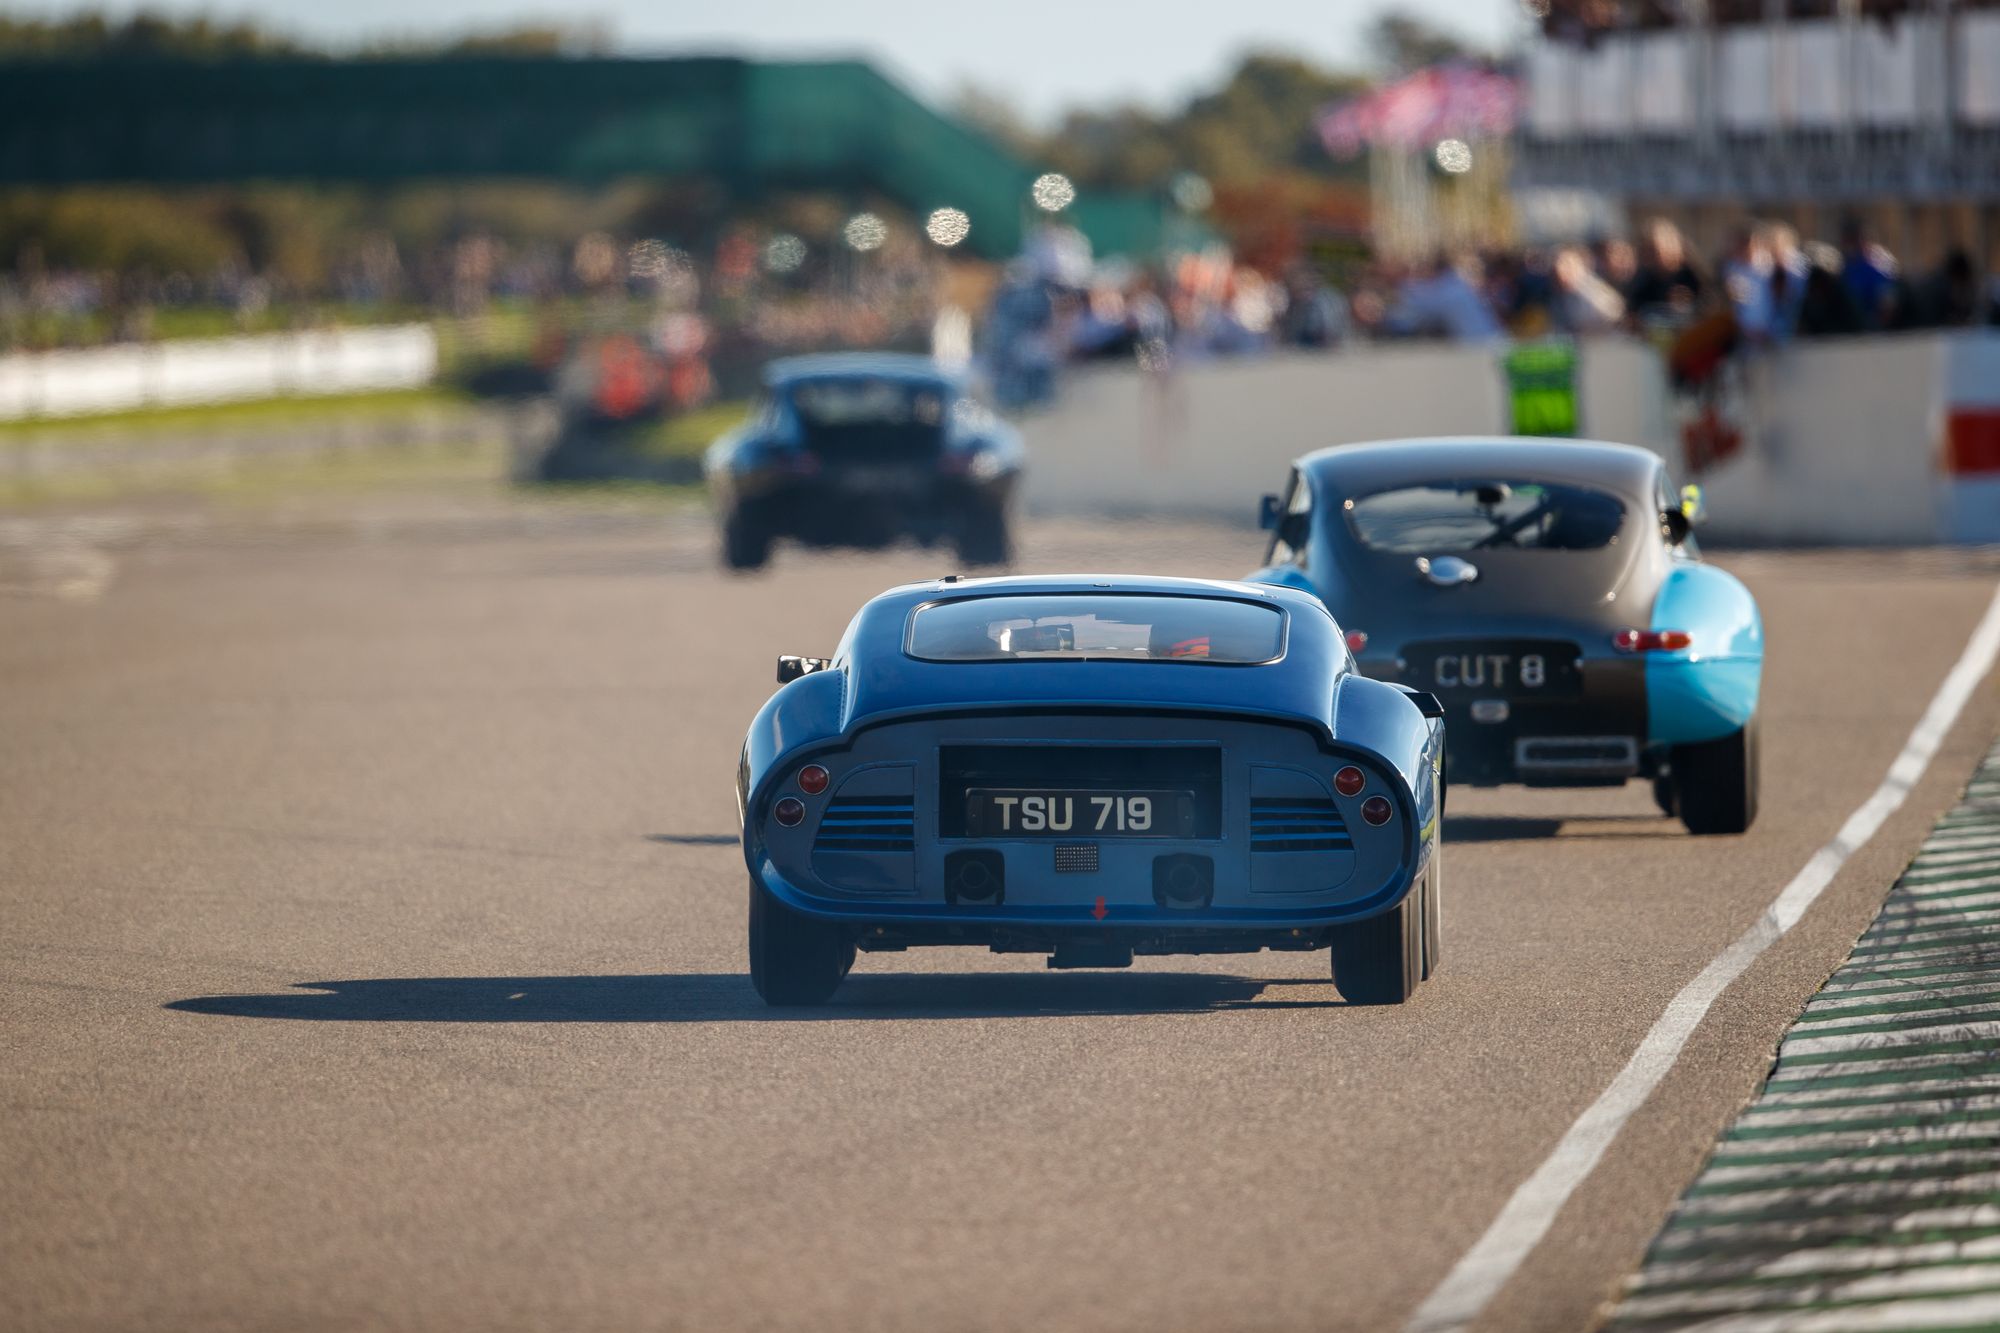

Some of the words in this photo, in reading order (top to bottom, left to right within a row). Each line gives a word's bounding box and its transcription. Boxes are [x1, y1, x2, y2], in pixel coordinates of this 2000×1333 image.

[1435, 655, 1510, 687] CUT
[1520, 655, 1545, 687] 8
[994, 797, 1073, 831] TSU
[1091, 797, 1152, 831] 719
